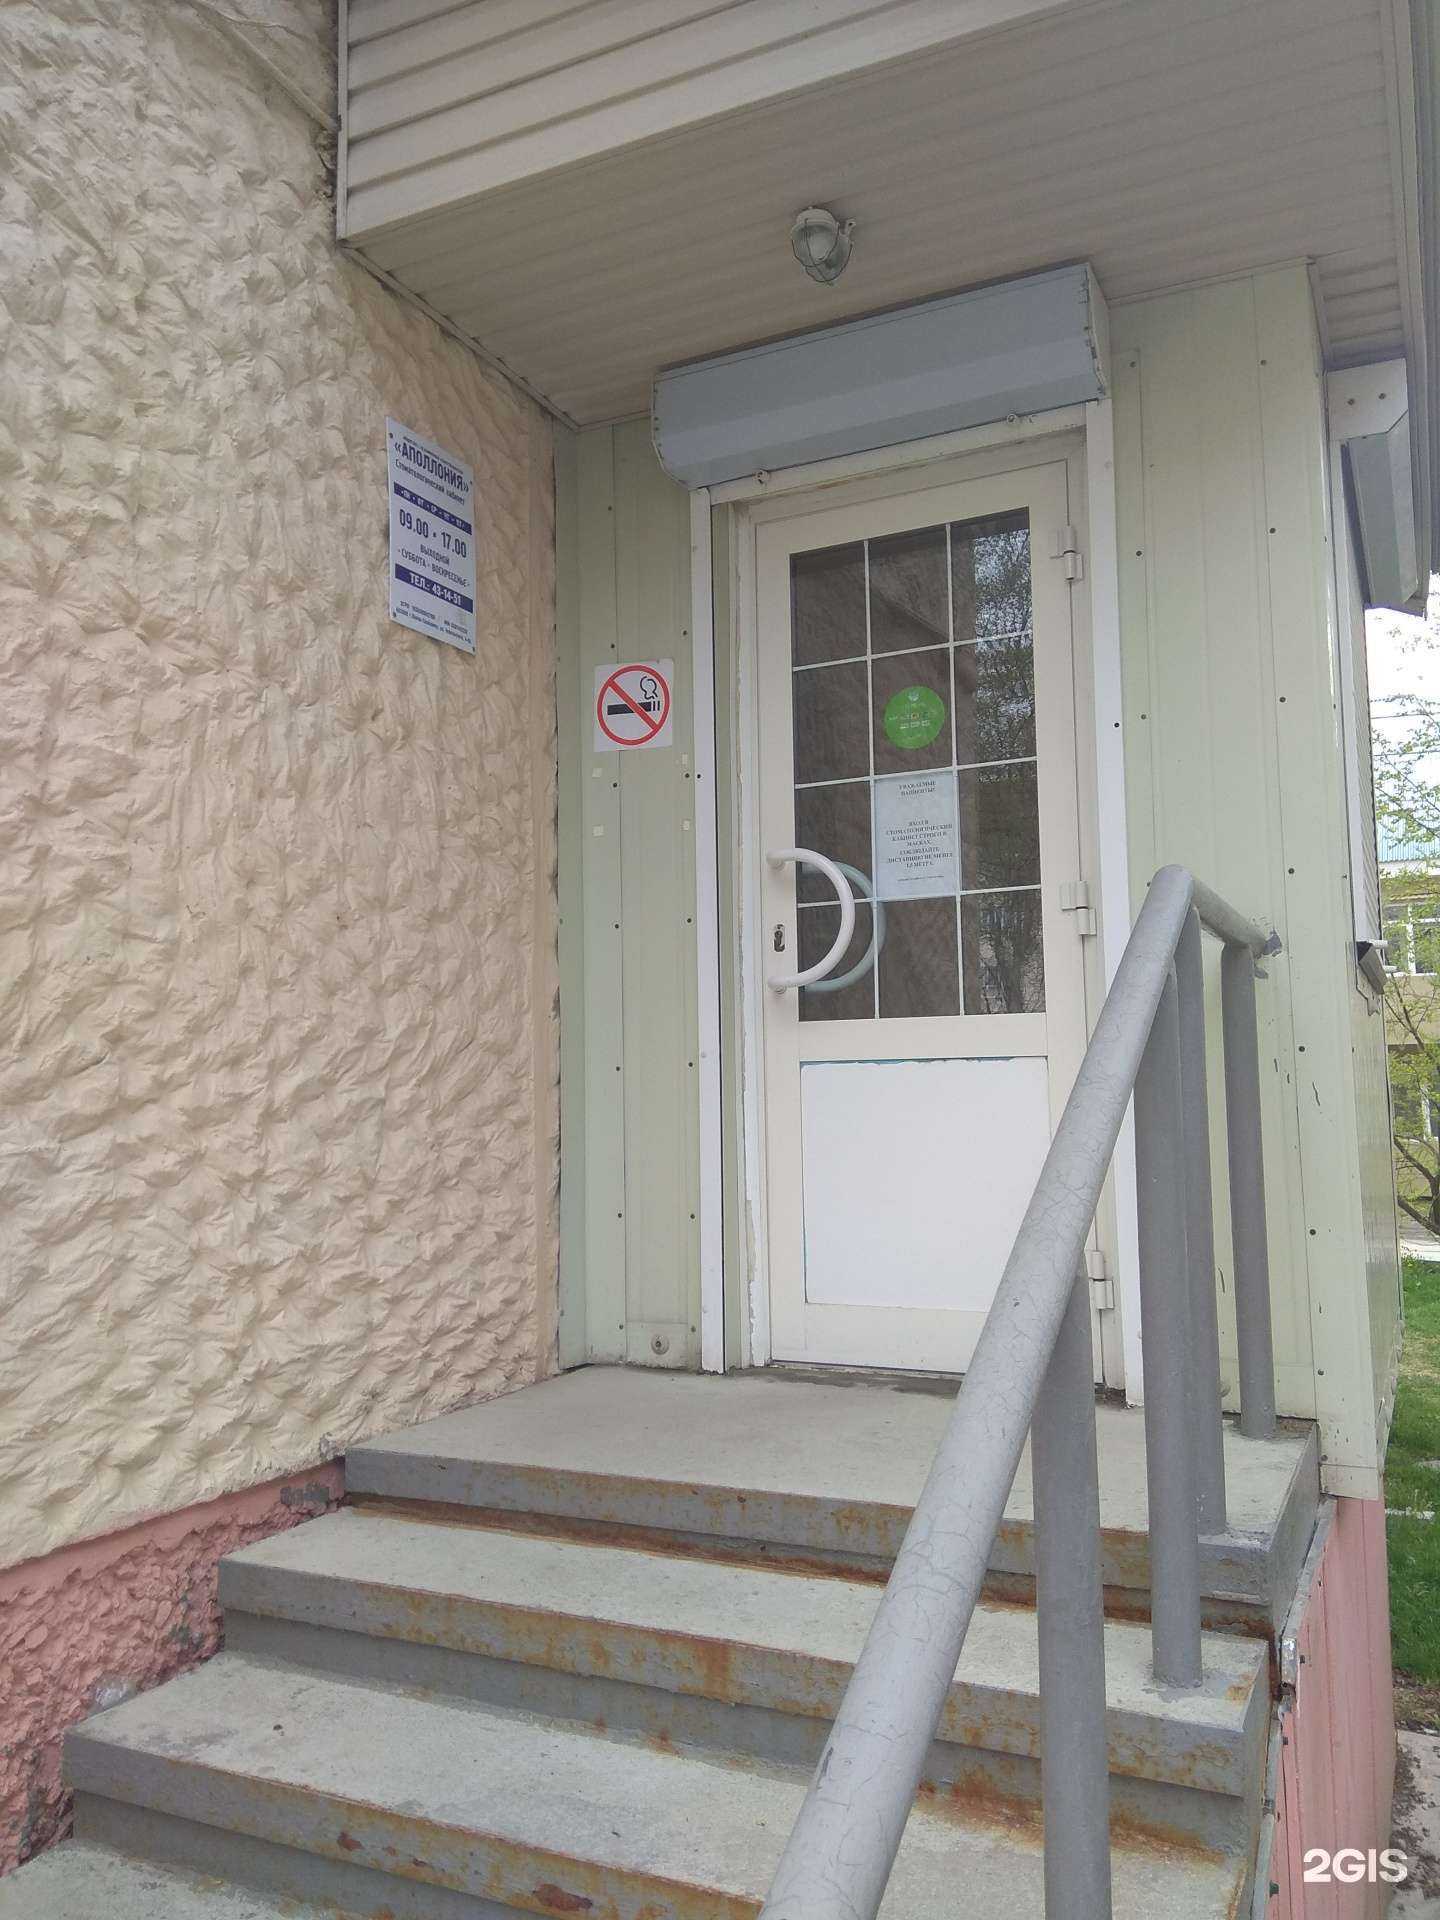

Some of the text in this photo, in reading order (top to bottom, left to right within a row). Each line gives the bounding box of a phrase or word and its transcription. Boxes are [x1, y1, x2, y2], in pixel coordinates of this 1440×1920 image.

[394, 442, 469, 492] «АПОЛЛОНИЯ»
[396, 459, 445, 492] Стоматологический
[400, 509, 467, 558] 09.00 17.00
[401, 548, 426, 568] СУББОТА
[421, 544, 450, 565] ВЫХОДНОЙ
[432, 583, 462, 606] 43-14-51
